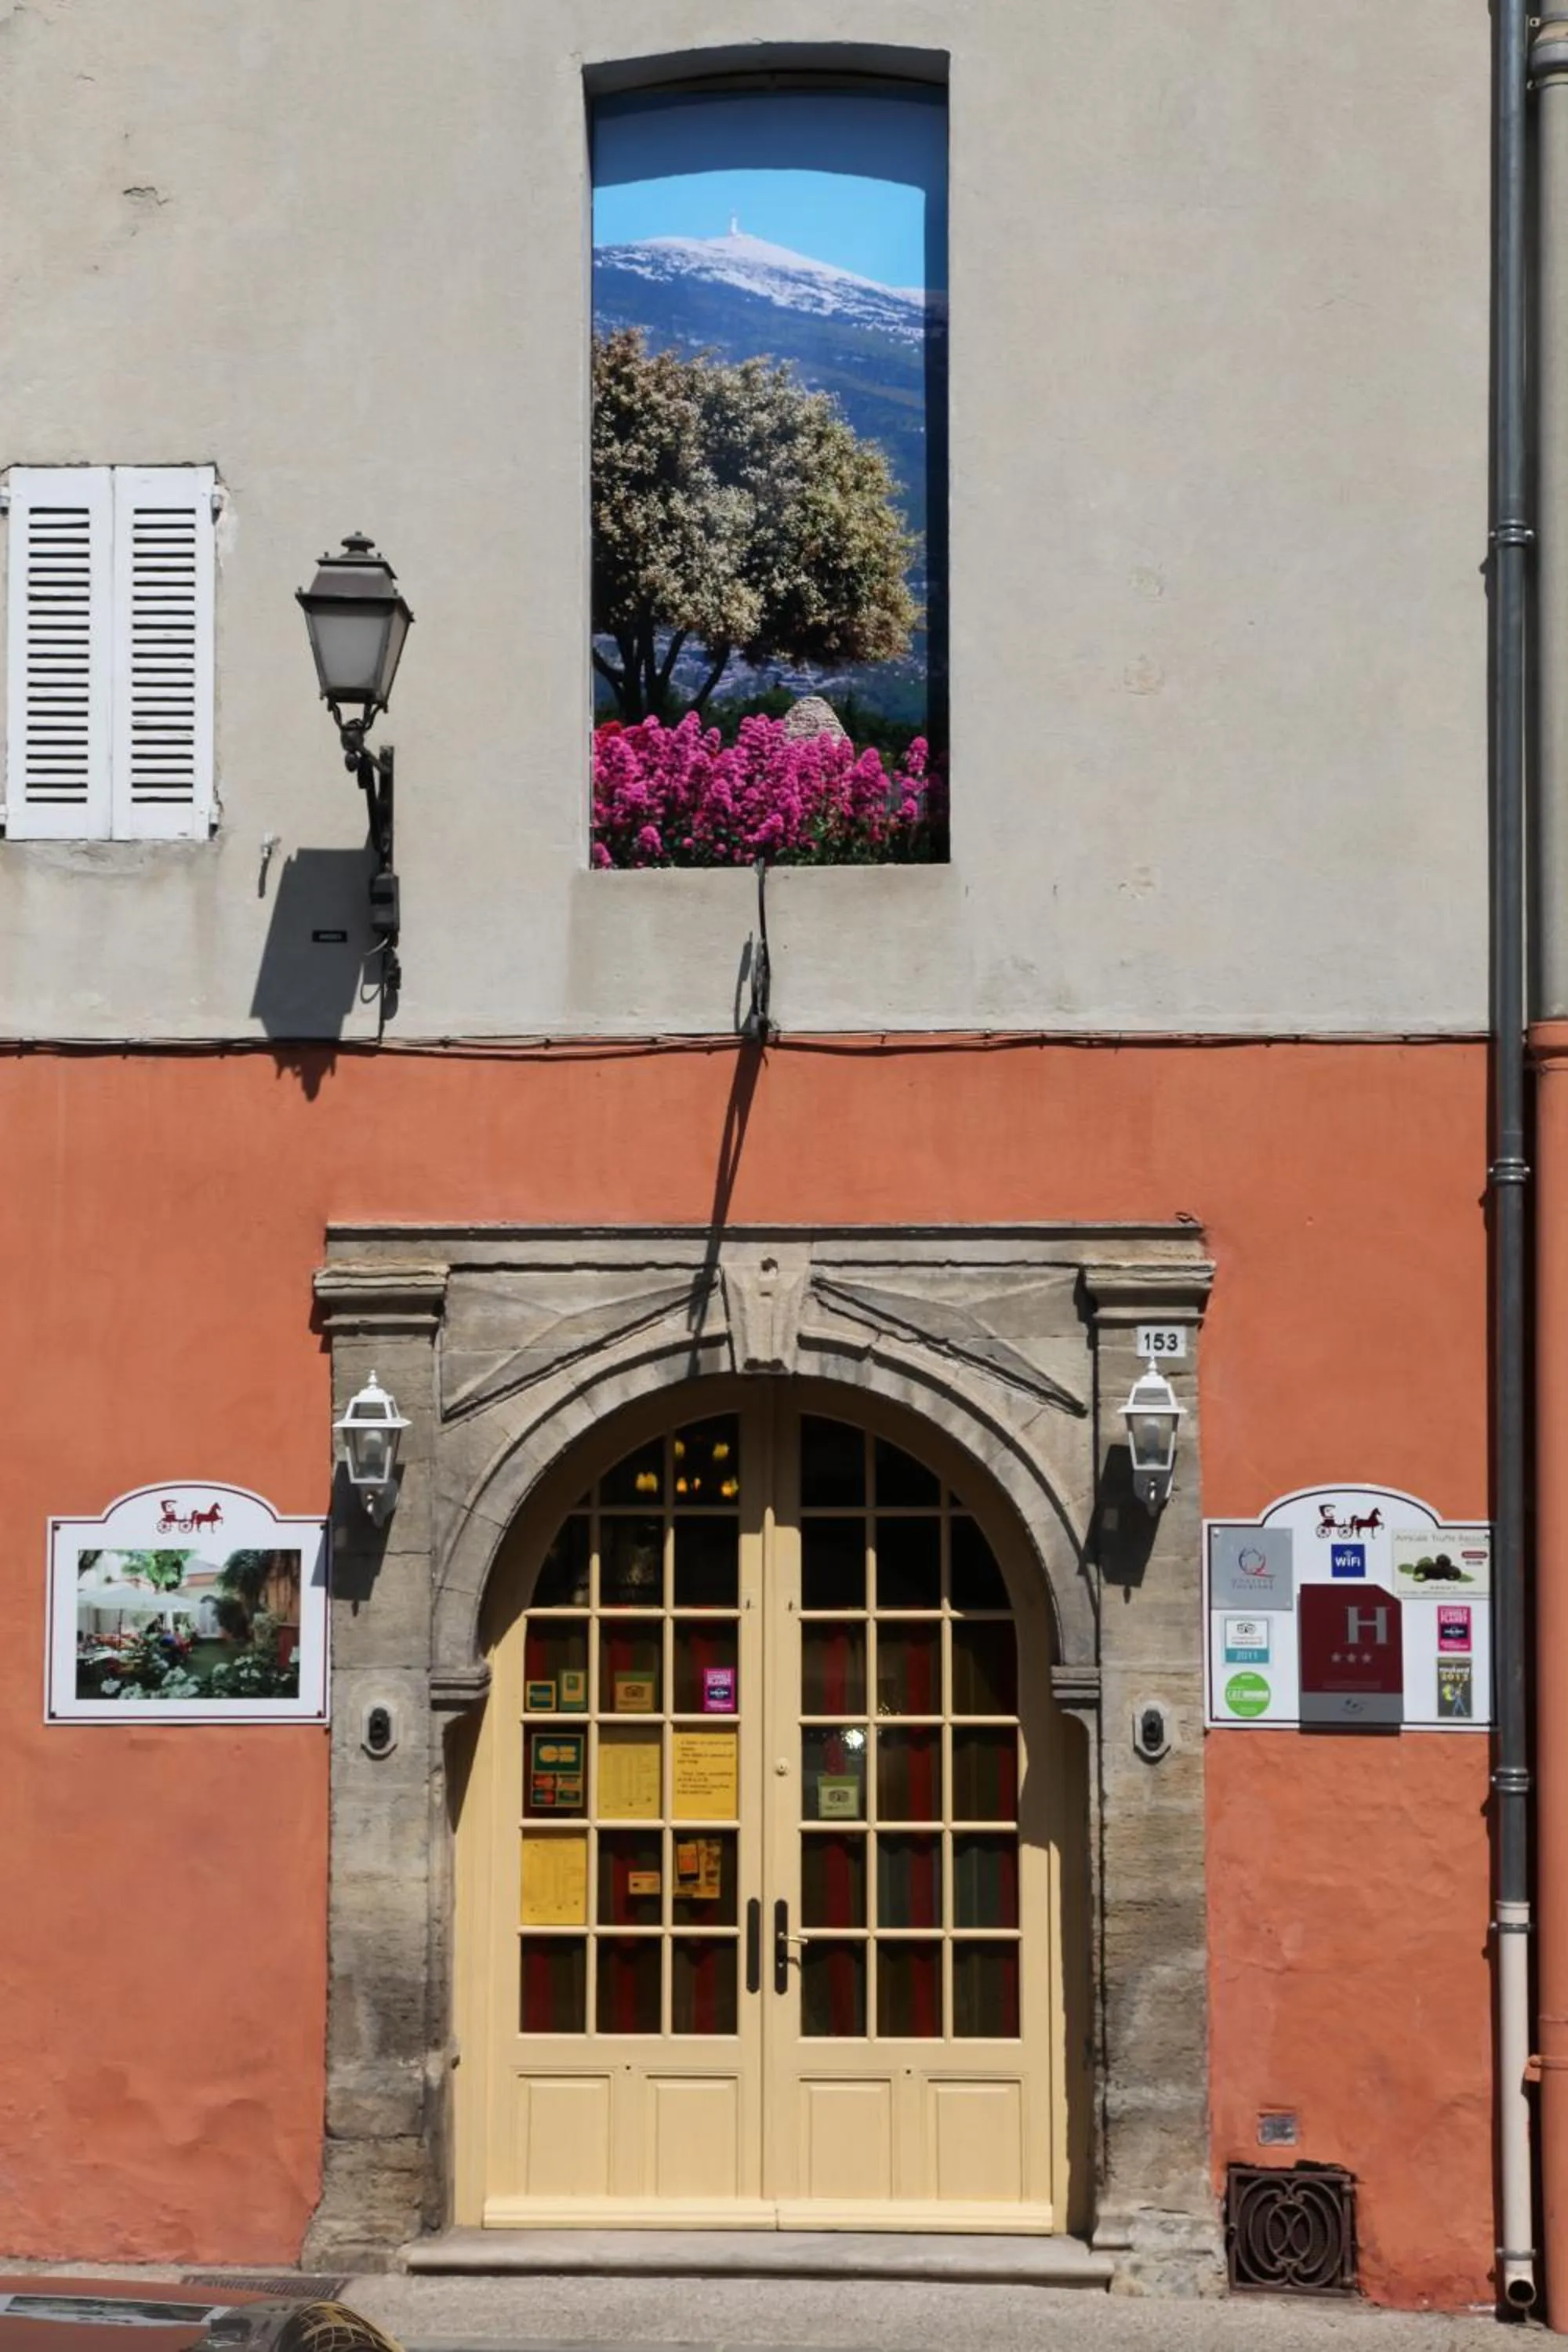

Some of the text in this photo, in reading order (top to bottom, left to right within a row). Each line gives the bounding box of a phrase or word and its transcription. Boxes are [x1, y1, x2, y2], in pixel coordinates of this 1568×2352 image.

[1145, 1332, 1178, 1352] 153
[1335, 1555, 1361, 1567] WiFi
[1345, 1606, 1391, 1644] H
